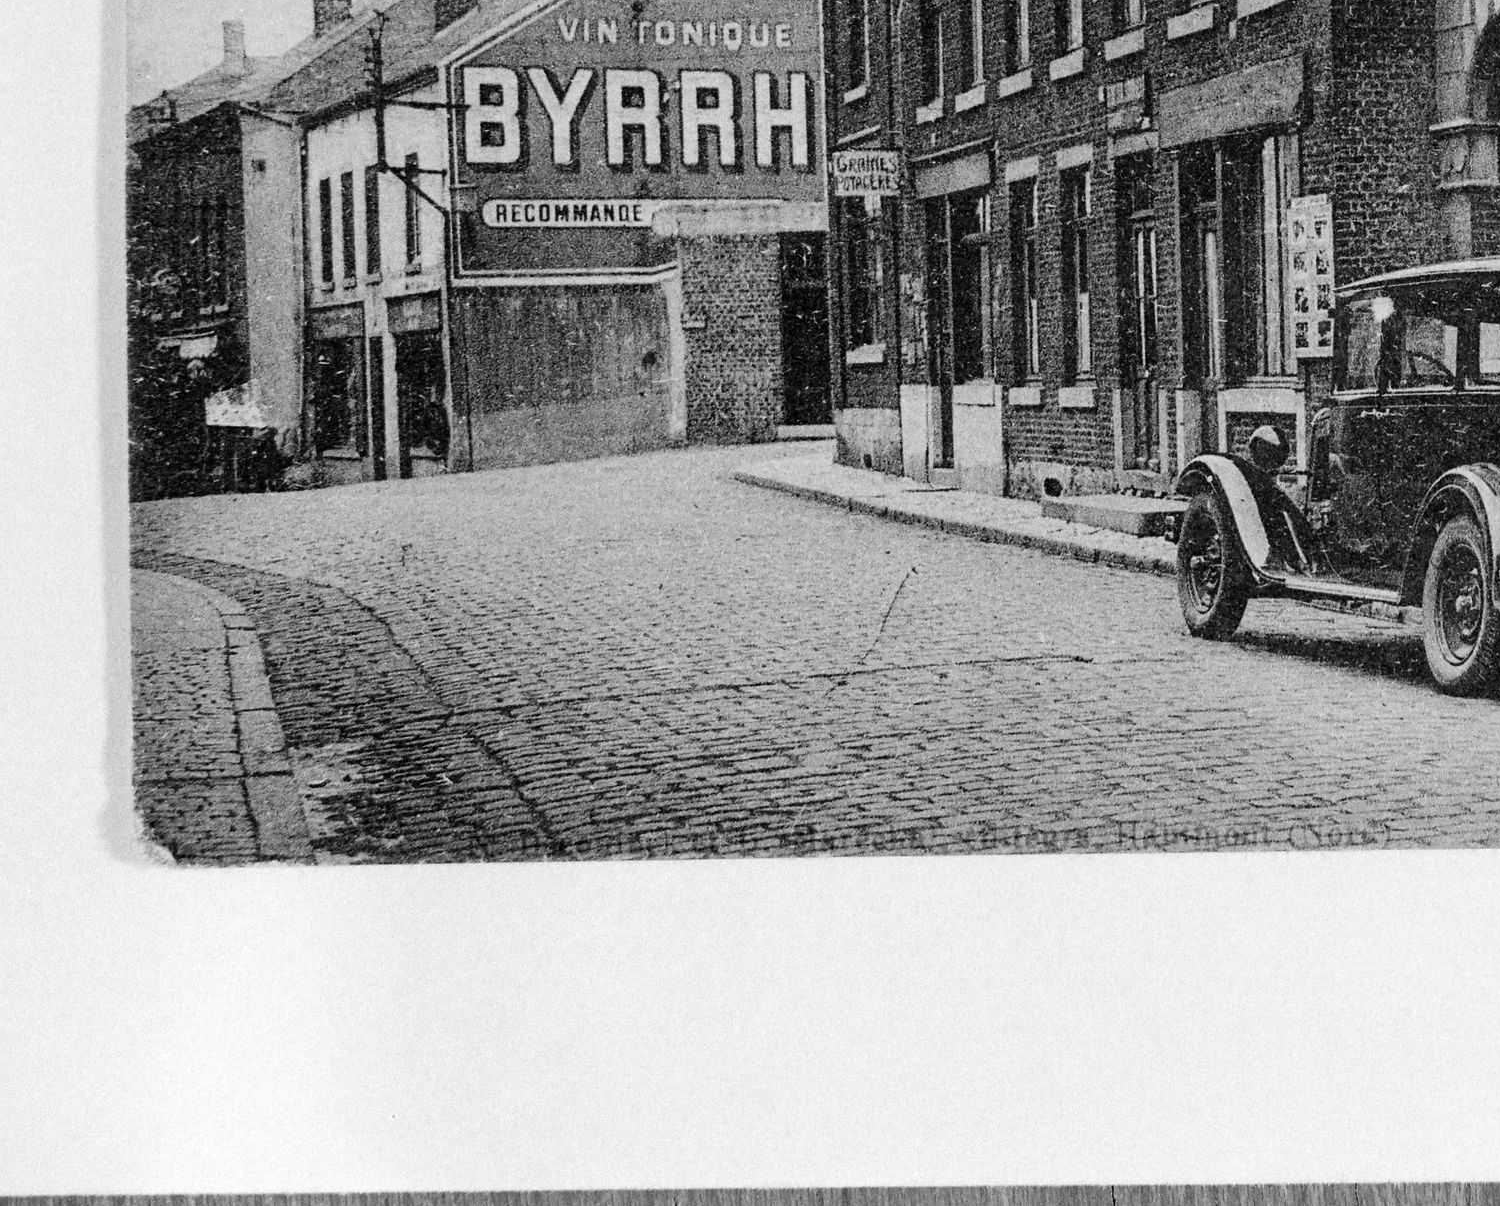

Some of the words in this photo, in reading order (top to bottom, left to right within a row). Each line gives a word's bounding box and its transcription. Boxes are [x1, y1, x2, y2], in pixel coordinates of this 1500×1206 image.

[556, 18, 618, 45] VIN
[634, 21, 794, 51] TONIQUE
[463, 66, 812, 169] BYRRH
